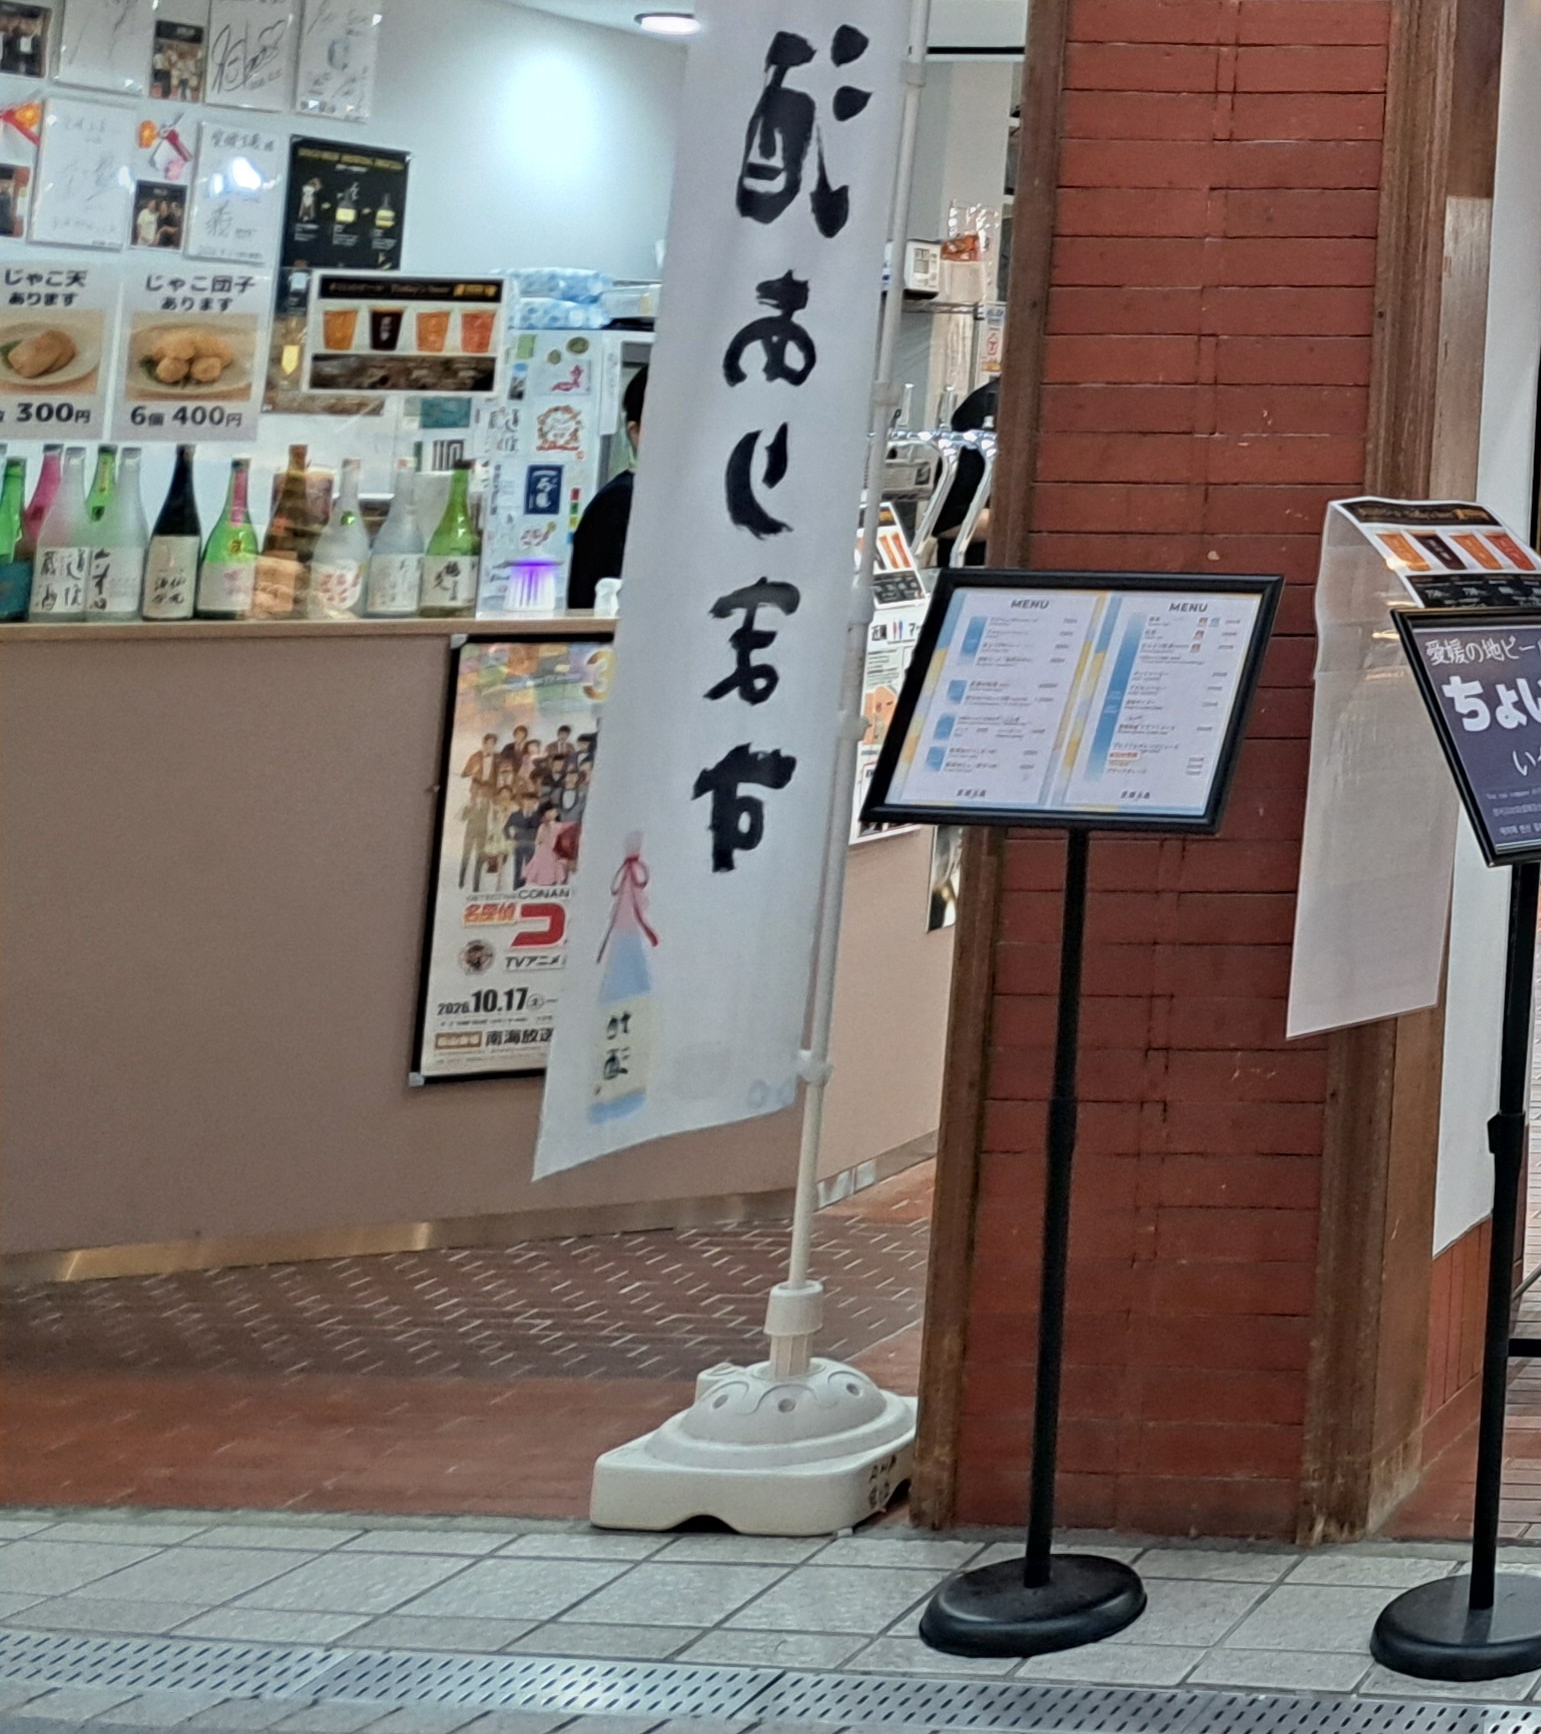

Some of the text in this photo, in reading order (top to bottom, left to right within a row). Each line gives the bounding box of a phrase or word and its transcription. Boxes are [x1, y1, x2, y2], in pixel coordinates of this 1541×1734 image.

[4, 268, 88, 287] じゃこ天
[145, 274, 255, 293] じゃこ団子
[8, 292, 79, 307] あります
[161, 297, 234, 313] あります
[16, 401, 92, 424] 300円
[172, 405, 243, 428] 400円
[1010, 599, 1050, 610] MENU
[1168, 602, 1208, 613] MENU
